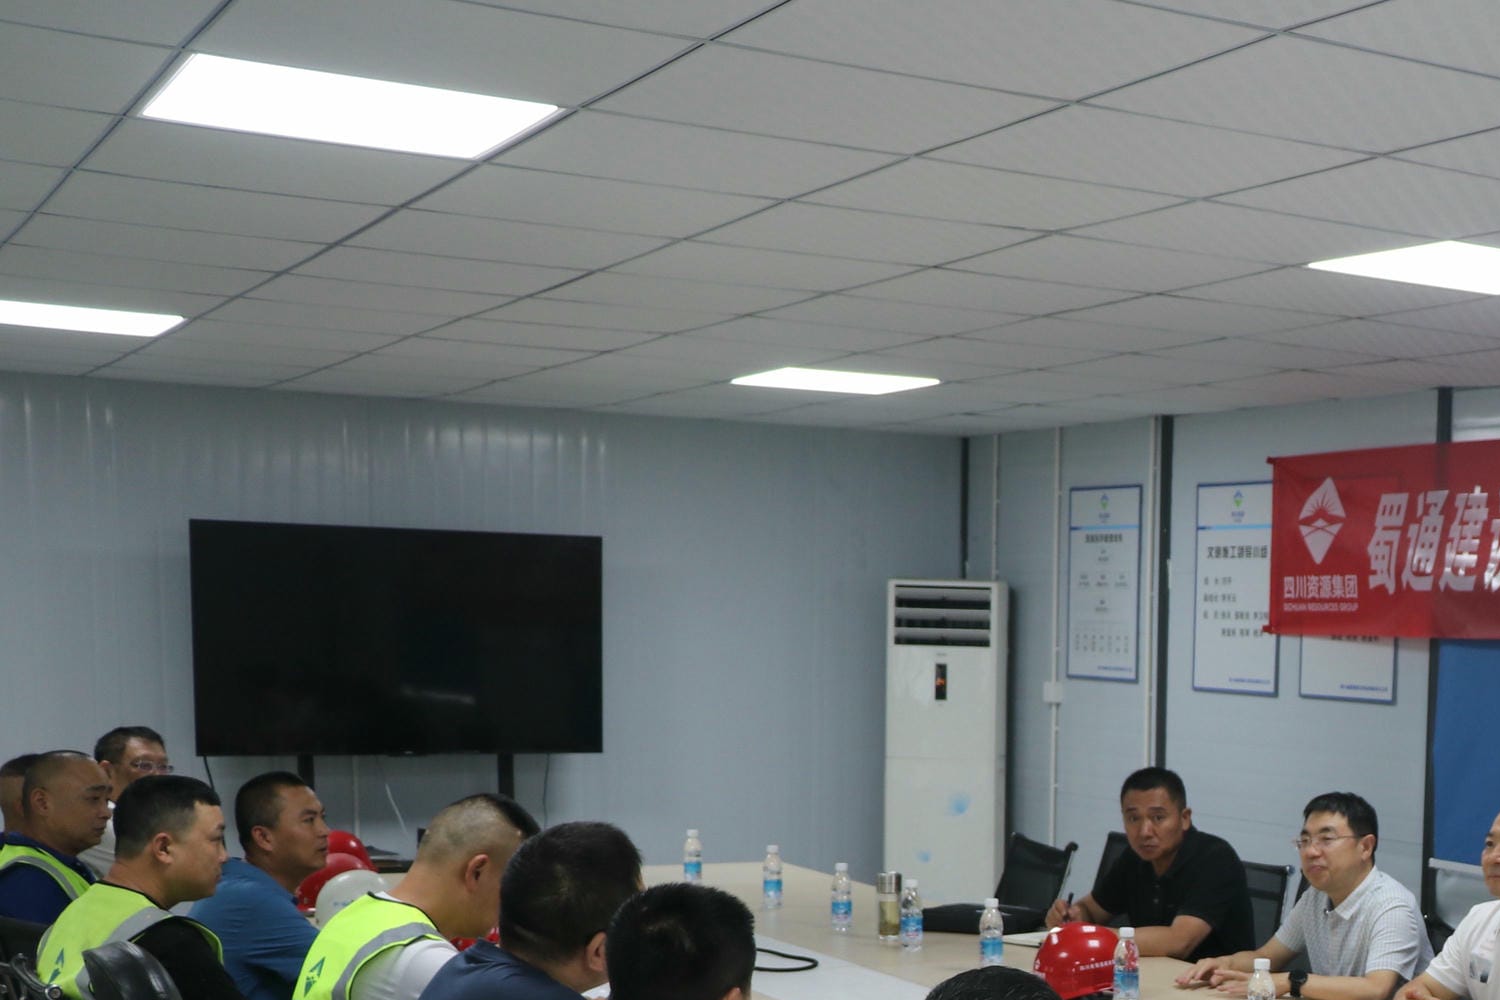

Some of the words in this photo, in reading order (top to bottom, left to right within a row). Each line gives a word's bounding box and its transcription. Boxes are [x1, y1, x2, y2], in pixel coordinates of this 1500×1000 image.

[1284, 575, 1358, 598] 四川资源集团
